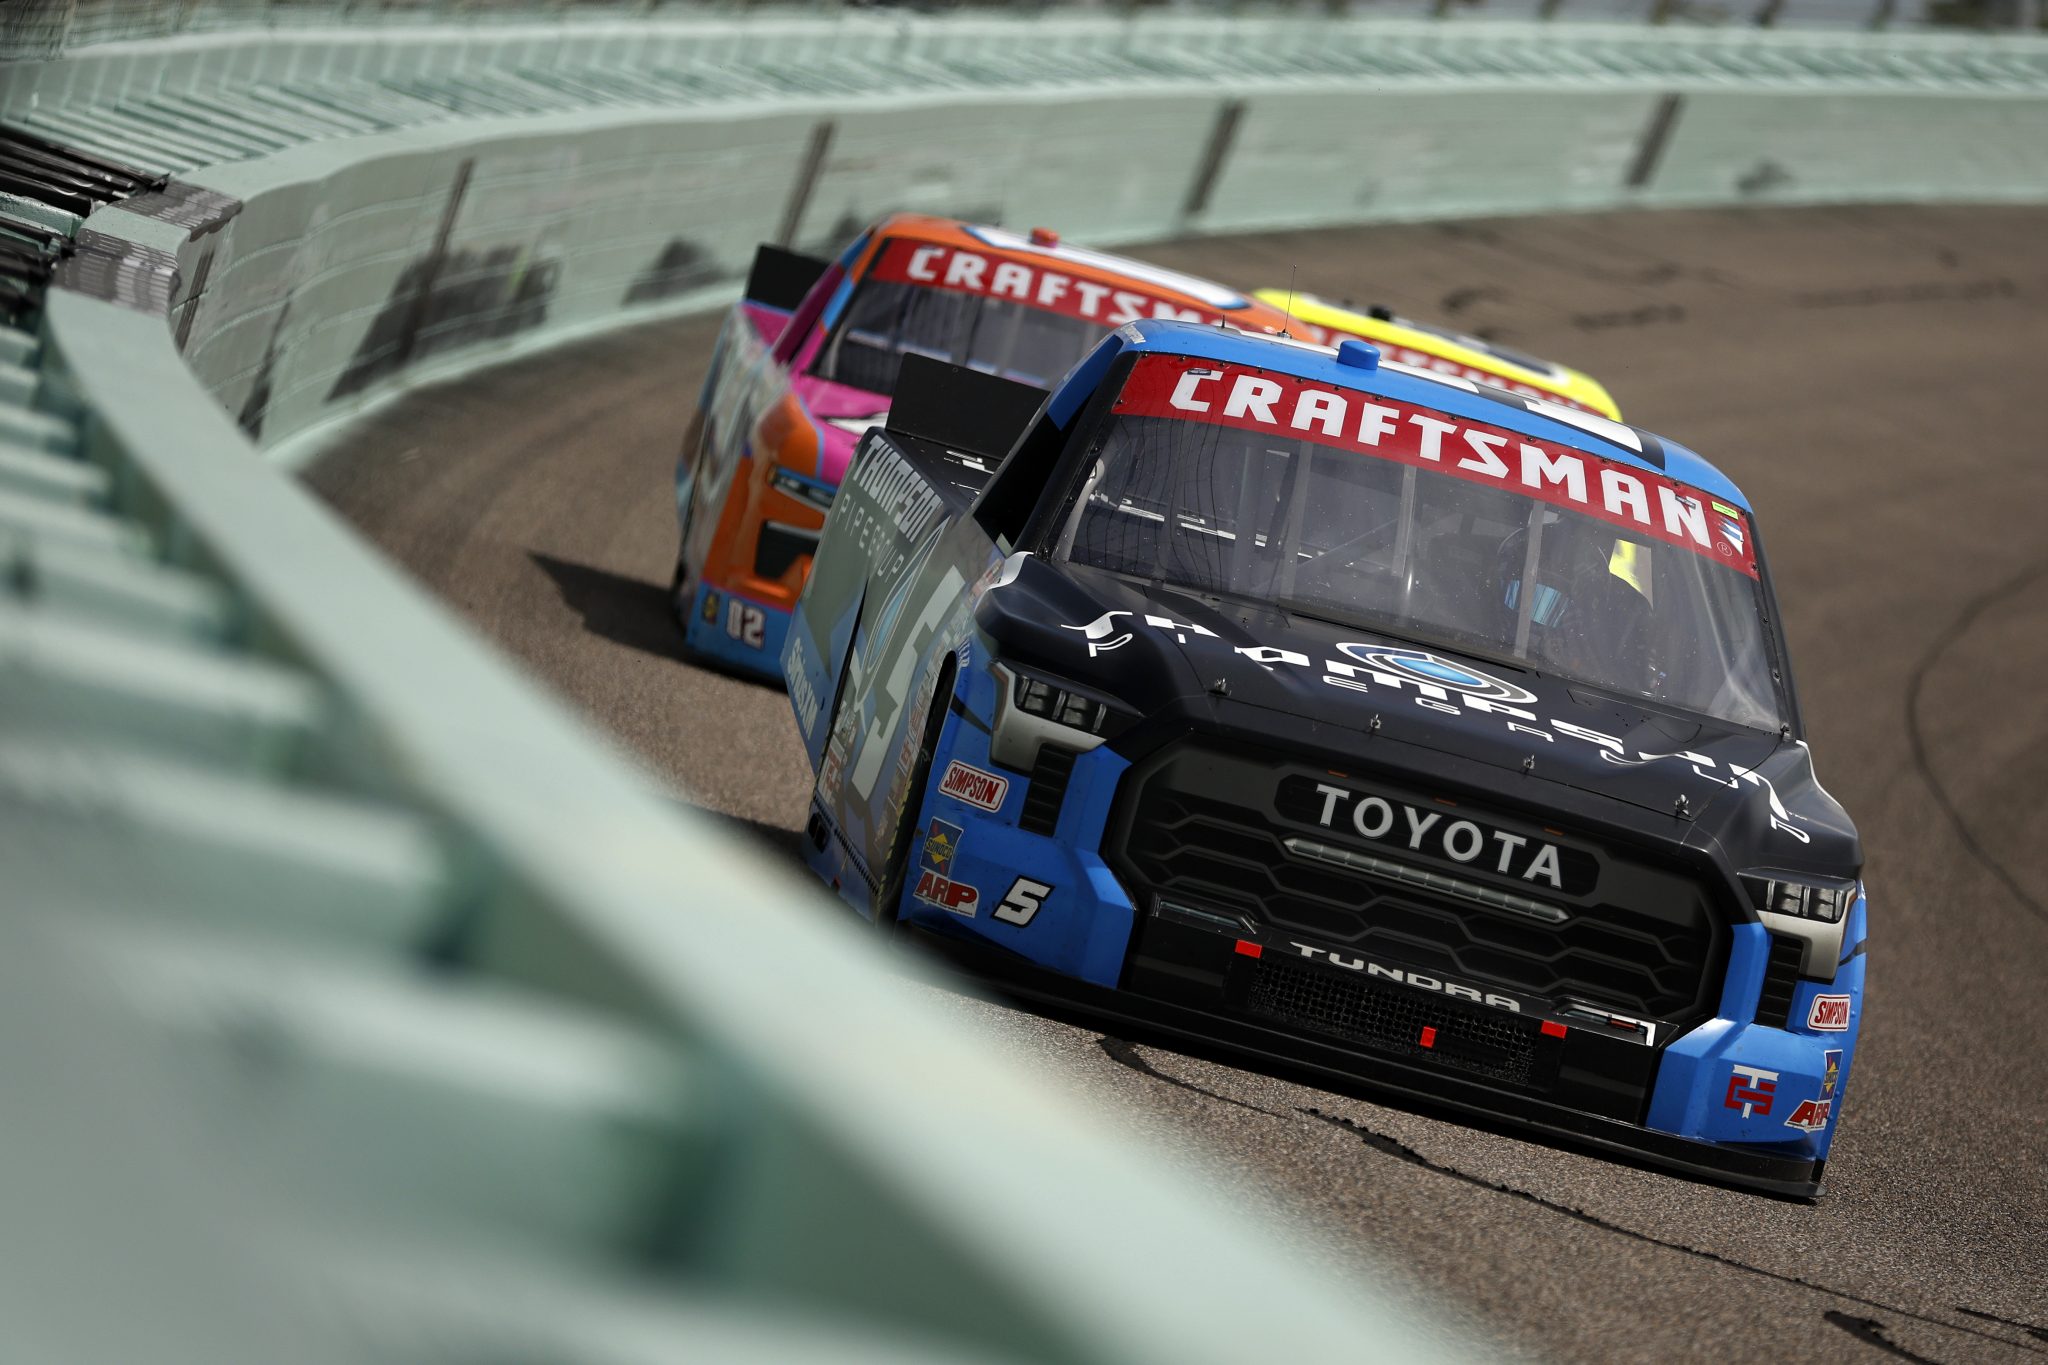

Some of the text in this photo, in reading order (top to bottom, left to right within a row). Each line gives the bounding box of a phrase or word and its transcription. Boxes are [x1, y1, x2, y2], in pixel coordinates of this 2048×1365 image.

[907, 247, 1240, 329] CRAFTSM
[1168, 369, 1712, 549] CRAFTSMAN
[853, 434, 943, 543] THOMPSON
[944, 766, 1000, 804] SIMPSON
[926, 838, 954, 860] SUNOCO
[1316, 784, 1563, 890] TOYOTA
[915, 872, 978, 908] ARP
[992, 876, 1053, 926] 5
[1290, 941, 1521, 1013] TUNDRA
[1814, 1000, 1849, 1025] SIMPSON
[1789, 1101, 1831, 1127] ARP
